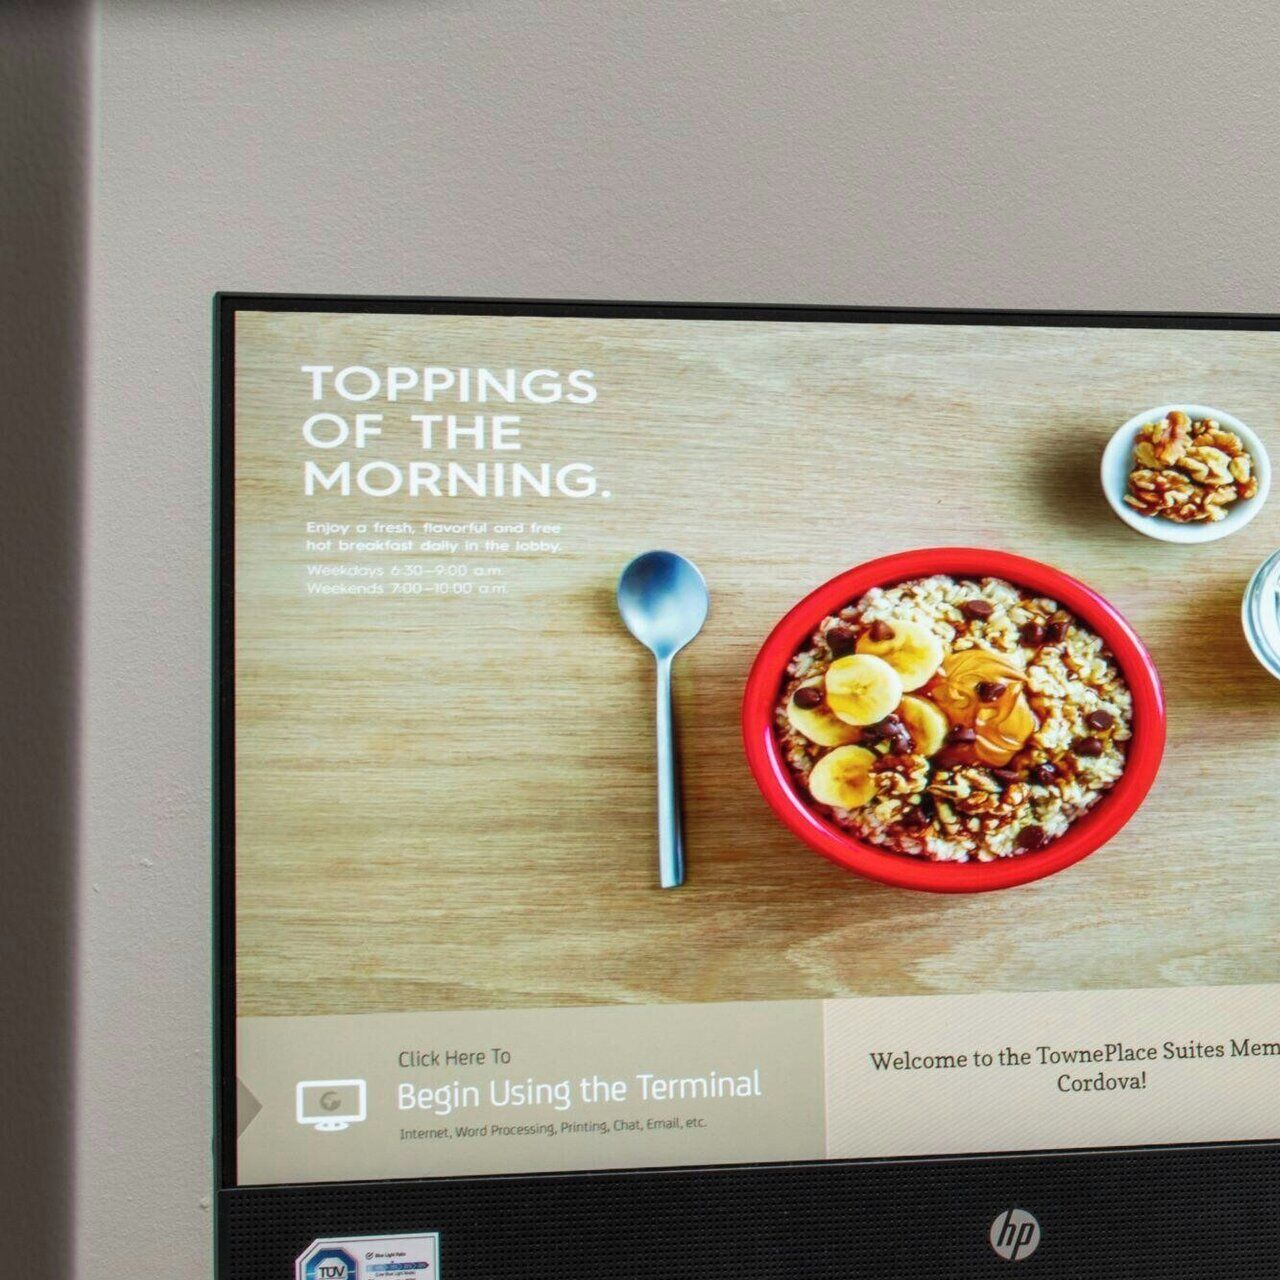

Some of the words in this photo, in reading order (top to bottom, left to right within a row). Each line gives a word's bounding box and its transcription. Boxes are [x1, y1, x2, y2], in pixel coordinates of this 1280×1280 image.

[301, 365, 598, 404] TOPPINGS
[302, 412, 384, 449] OF
[411, 414, 522, 450] THE
[304, 460, 612, 499] MORNING.
[306, 521, 350, 535] Enjoy
[356, 524, 367, 533] a
[373, 522, 415, 535] fresh,
[423, 522, 487, 534] flavorful
[494, 522, 524, 534] and
[530, 522, 561, 534] free
[306, 540, 331, 551] hot
[339, 540, 413, 552] breakfast
[420, 540, 459, 554] daily
[465, 541, 479, 551] in
[485, 541, 510, 551] the
[516, 541, 562, 553] lobby.
[307, 565, 384, 578] Weekdays
[307, 582, 384, 595] Weekends
[399, 1050, 440, 1067] Click
[446, 1051, 486, 1066] Here
[491, 1048, 511, 1064] To
[870, 1049, 968, 1070] Welcome
[974, 1048, 993, 1068] to
[1000, 1046, 1031, 1066] the
[1036, 1043, 1158, 1064] TownePlace
[1163, 1041, 1225, 1060] Suites
[398, 1080, 480, 1115] Begin
[490, 1077, 571, 1111] Using
[580, 1076, 627, 1103] the
[636, 1069, 762, 1101] Terminal
[1057, 1072, 1147, 1093] Cordova!
[400, 1127, 453, 1140] Internet,
[455, 1126, 488, 1138] Word
[491, 1122, 558, 1137] Processing,
[560, 1118, 610, 1135] Printing,
[613, 1118, 644, 1132] Chat,
[646, 1117, 684, 1131] Email,
[993, 1209, 1036, 1261] hp
